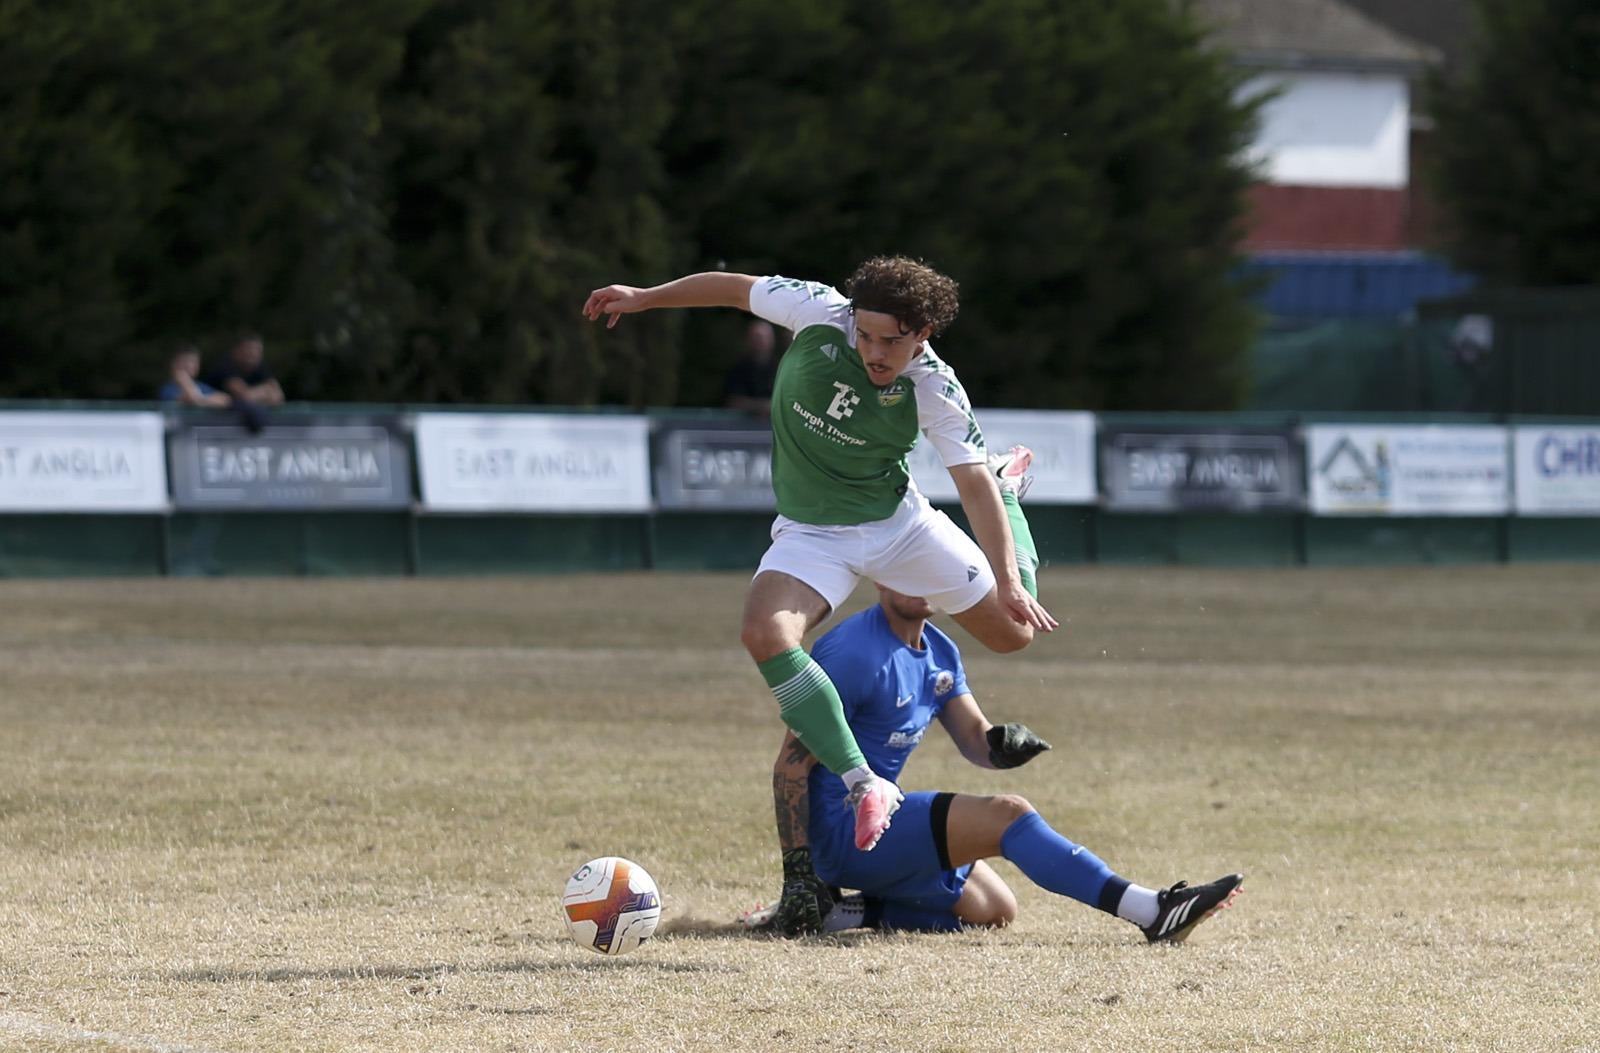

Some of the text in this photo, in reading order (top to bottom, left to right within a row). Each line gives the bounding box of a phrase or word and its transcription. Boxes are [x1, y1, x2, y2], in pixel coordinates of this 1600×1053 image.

[792, 401, 867, 446] Burgh Thorpe
[29, 446, 132, 480] ANGLIA
[203, 446, 381, 483] EAST ANGLIA
[455, 447, 619, 481] EAST ANGLIA
[684, 449, 748, 484] EAST
[1129, 451, 1281, 486] EAST ANGLIA
